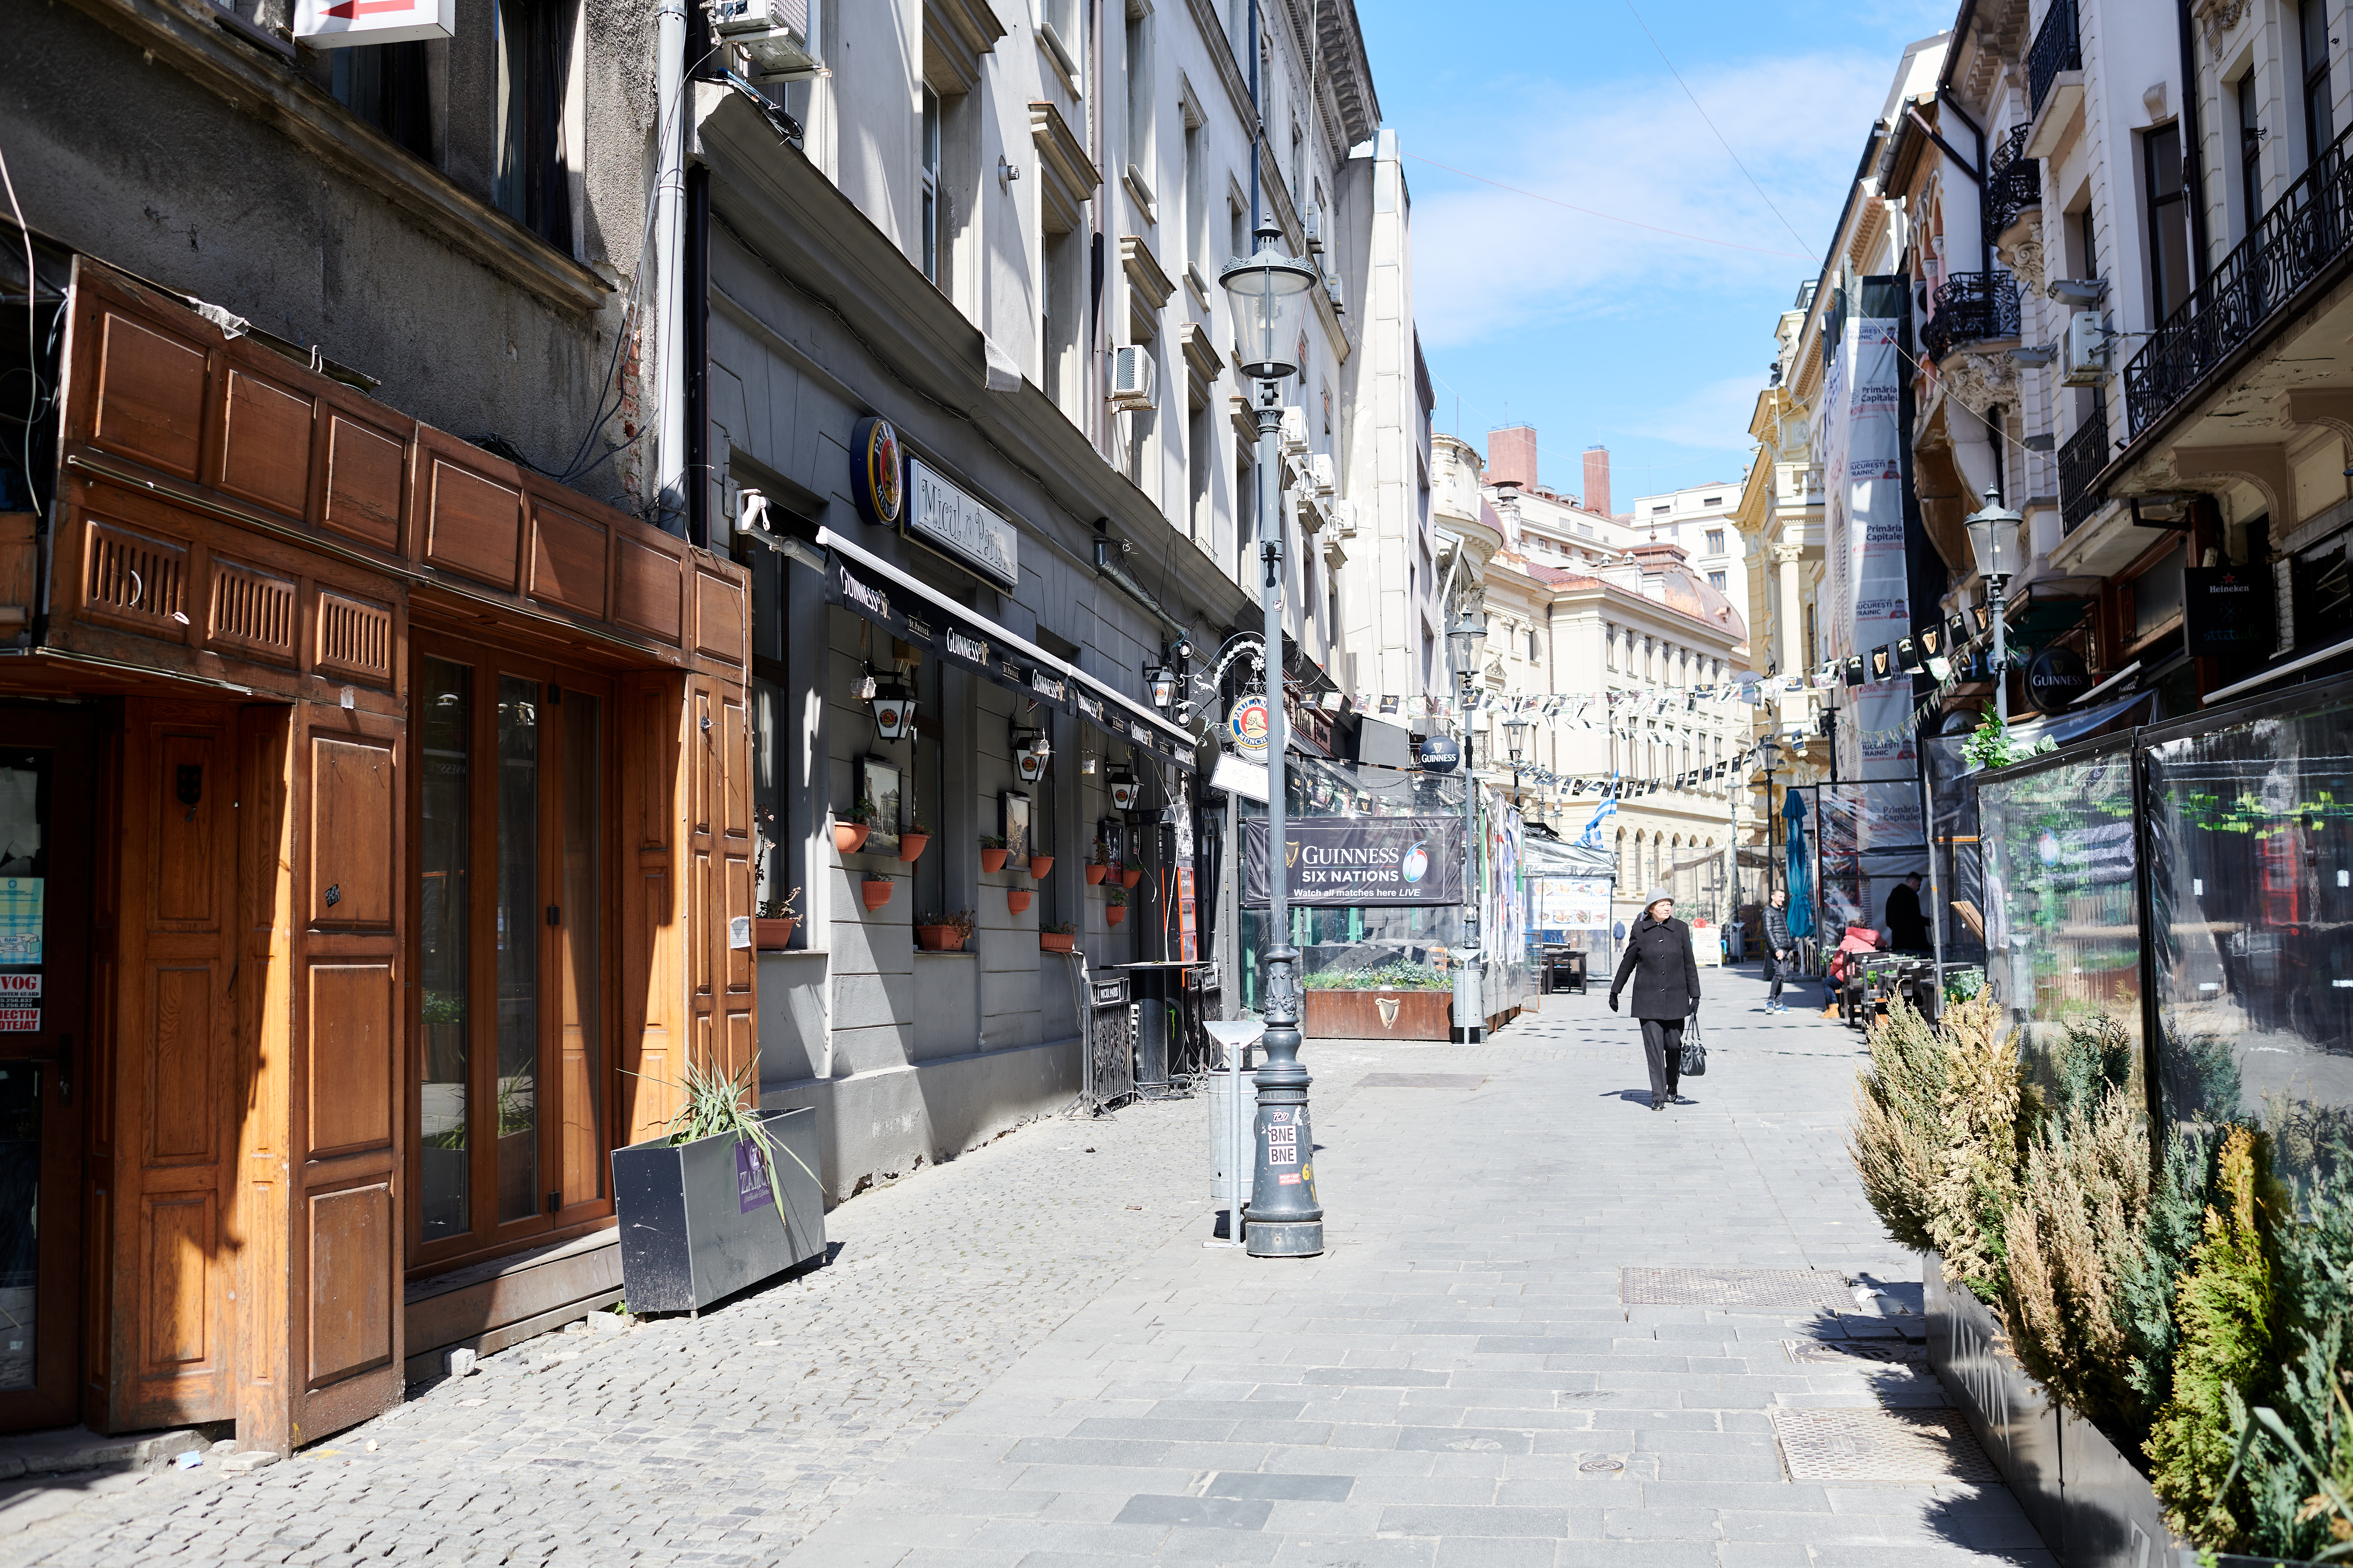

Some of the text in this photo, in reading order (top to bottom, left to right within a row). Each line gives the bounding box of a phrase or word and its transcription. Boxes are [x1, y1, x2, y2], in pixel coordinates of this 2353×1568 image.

[1861, 394, 1898, 403] Capitalei
[921, 479, 1015, 576] Micul Paris BISTRO
[1867, 524, 1902, 532] Primăria
[1867, 532, 1903, 542] Capitalei
[2210, 584, 2249, 593] Heineken
[2032, 675, 2082, 687] GUINNESS
[1233, 699, 1267, 721] PAULAN
[1237, 731, 1267, 744] MÜNCH
[1421, 754, 1456, 763] GUINNESS
[1883, 804, 1919, 813] Primăria
[1883, 813, 1920, 822] Capitalei
[1302, 845, 1399, 865] GUINNESS
[1302, 870, 1399, 882] SIX NATIONS
[1294, 888, 1421, 897] Watch all matches here LIVE
[1271, 1127, 1294, 1142] BNE
[1271, 1148, 1294, 1162] BNE
[740, 1165, 770, 1195] ZAMO
[1948, 1302, 2010, 1453] ZAMON
